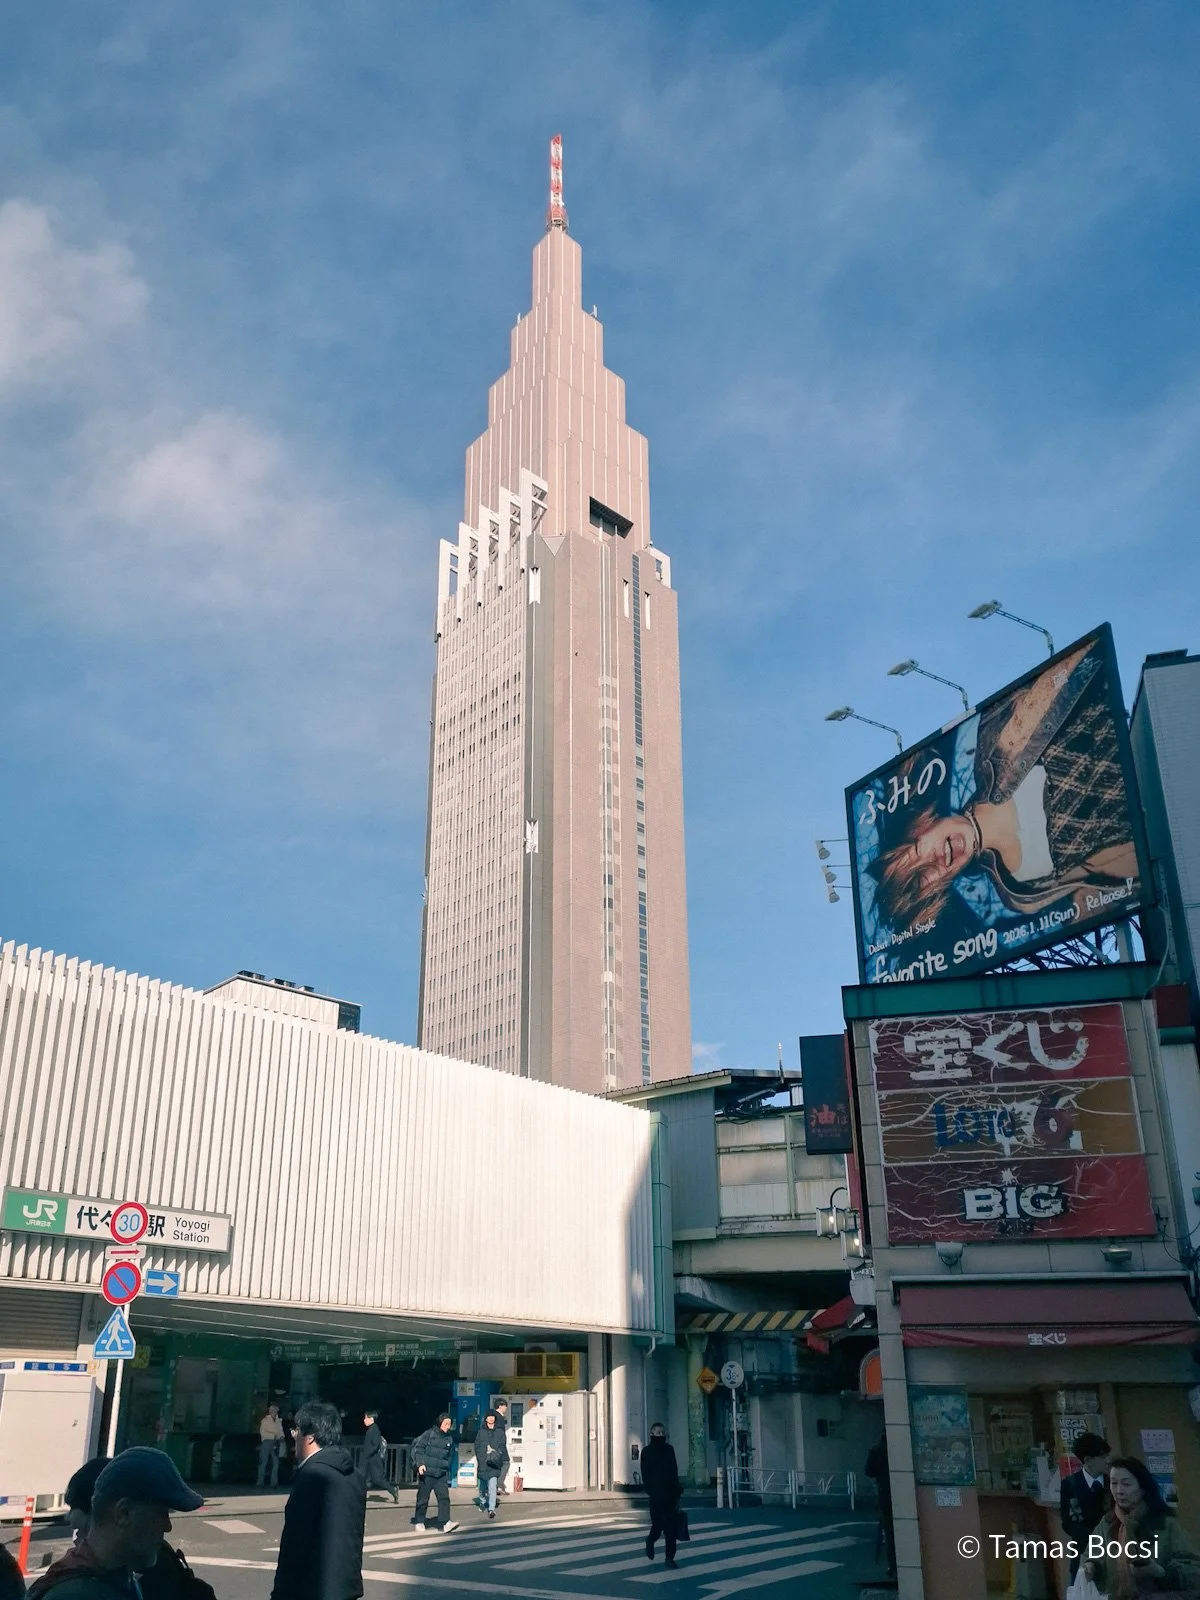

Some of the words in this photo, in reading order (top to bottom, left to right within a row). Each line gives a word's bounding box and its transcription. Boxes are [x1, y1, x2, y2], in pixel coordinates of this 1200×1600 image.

[859, 757, 947, 826] ふみの
[1085, 877, 1135, 911] Release!
[891, 925, 913, 945] Digital
[915, 917, 937, 935] Single
[872, 950, 948, 984] favorite
[952, 928, 998, 964] song
[903, 1020, 1090, 1081] 宝くじ
[22, 1198, 59, 1221] JR
[963, 1185, 1065, 1221] BIG
[77, 1205, 166, 1238] 代々駅
[118, 1213, 140, 1232] 30
[174, 1216, 211, 1232] Yoyogi
[172, 1230, 210, 1244] Station
[1027, 1332, 1067, 1346] 宝くじ
